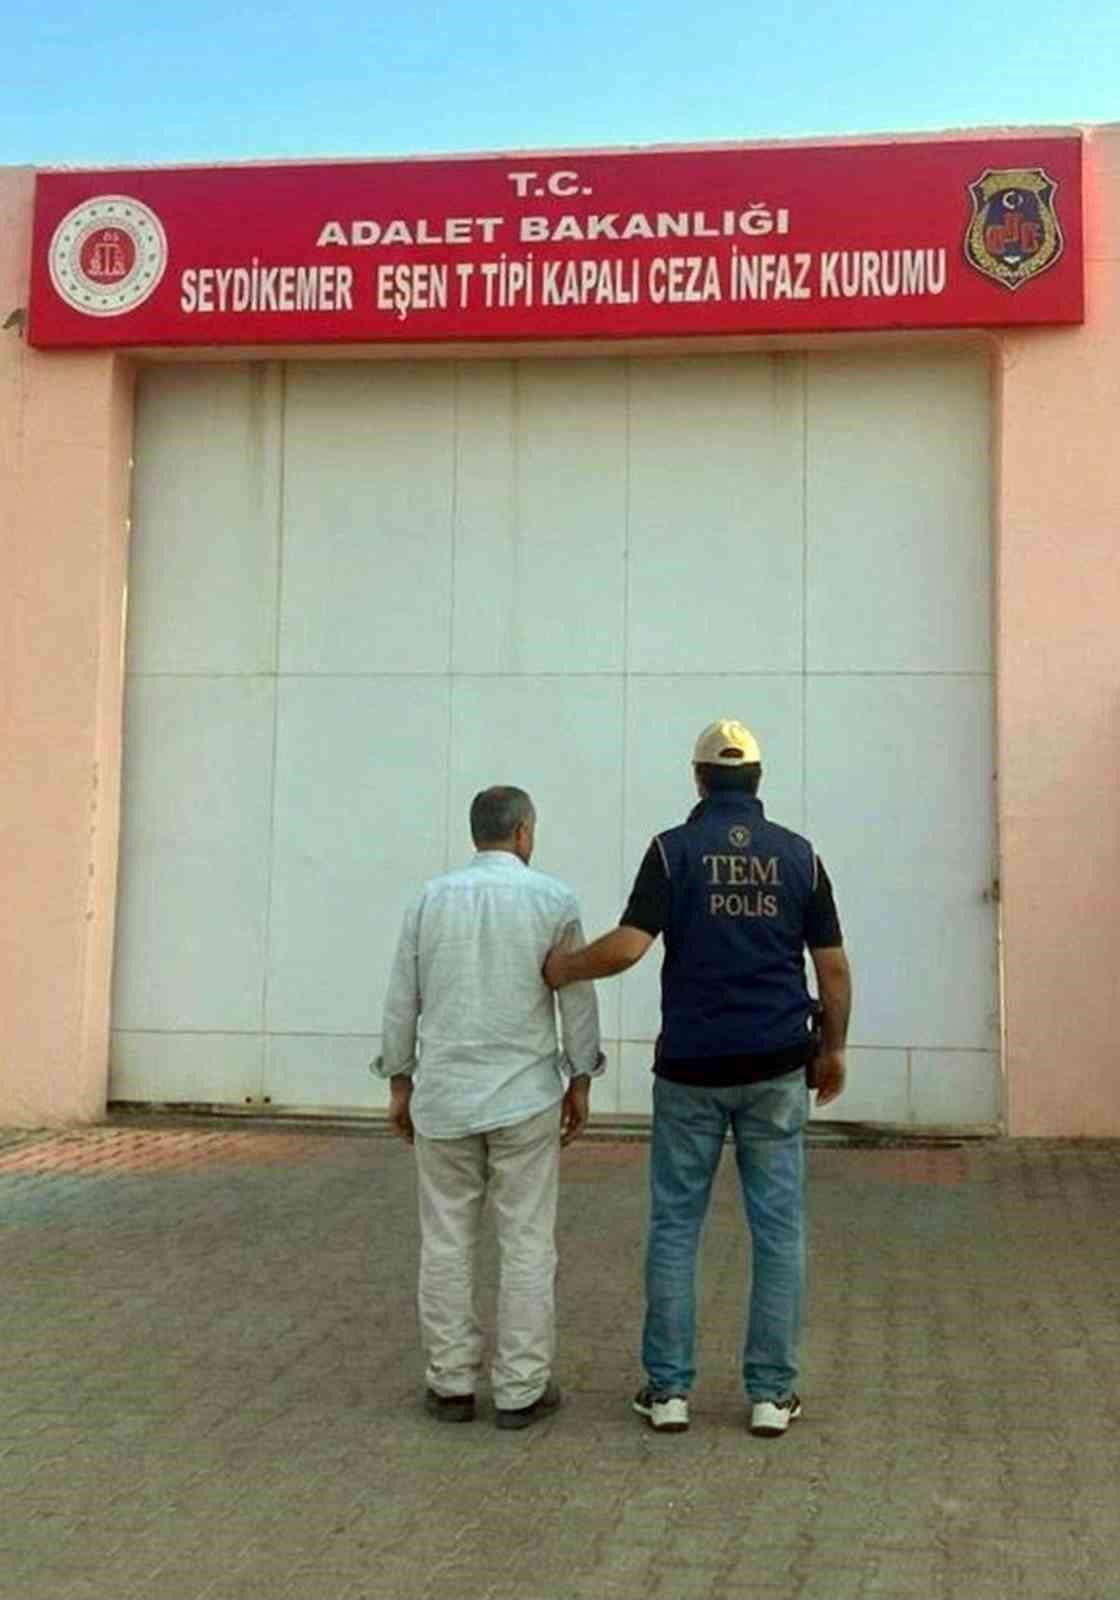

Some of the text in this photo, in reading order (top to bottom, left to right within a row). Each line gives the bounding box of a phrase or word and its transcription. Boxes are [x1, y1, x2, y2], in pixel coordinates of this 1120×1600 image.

[508, 171, 592, 197] T.C.
[316, 202, 789, 246] ADALET BAKANLIĞI
[179, 245, 947, 320] SEYDİKEMER EŞEN T TİPİ KAPALI CEZA İNFAZ KURUMU
[702, 854, 782, 887] TEM
[709, 891, 777, 917] POLİS
